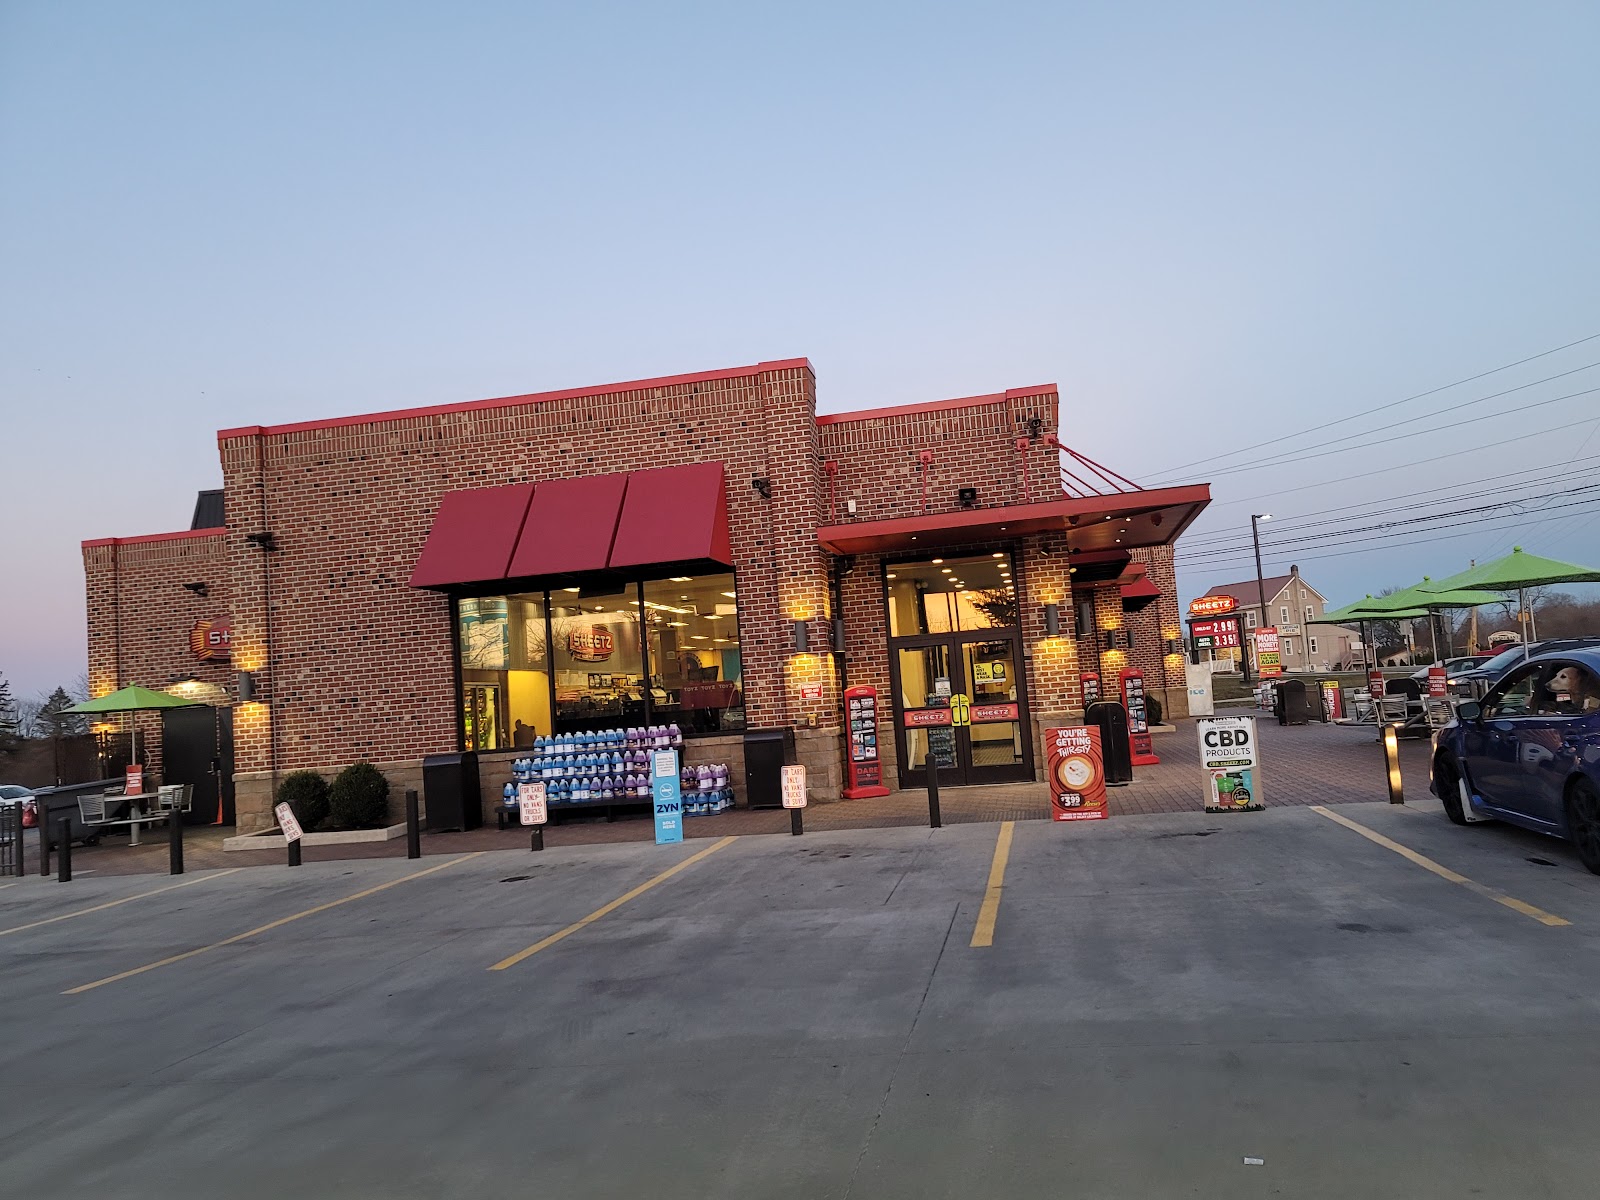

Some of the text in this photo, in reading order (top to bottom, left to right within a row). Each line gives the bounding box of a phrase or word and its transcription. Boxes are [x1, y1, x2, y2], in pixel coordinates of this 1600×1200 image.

[1192, 600, 1231, 610] SHEETZ
[573, 632, 611, 649] SHEETZ
[1256, 634, 1278, 642] MORE
[1058, 729, 1087, 738] YOU'RE
[1204, 730, 1249, 747] CBD
[1056, 737, 1091, 746] GETTING
[1057, 745, 1091, 757] THIRSTY
[1206, 748, 1250, 757] PRODUCTS
[657, 803, 678, 813] ZYN
